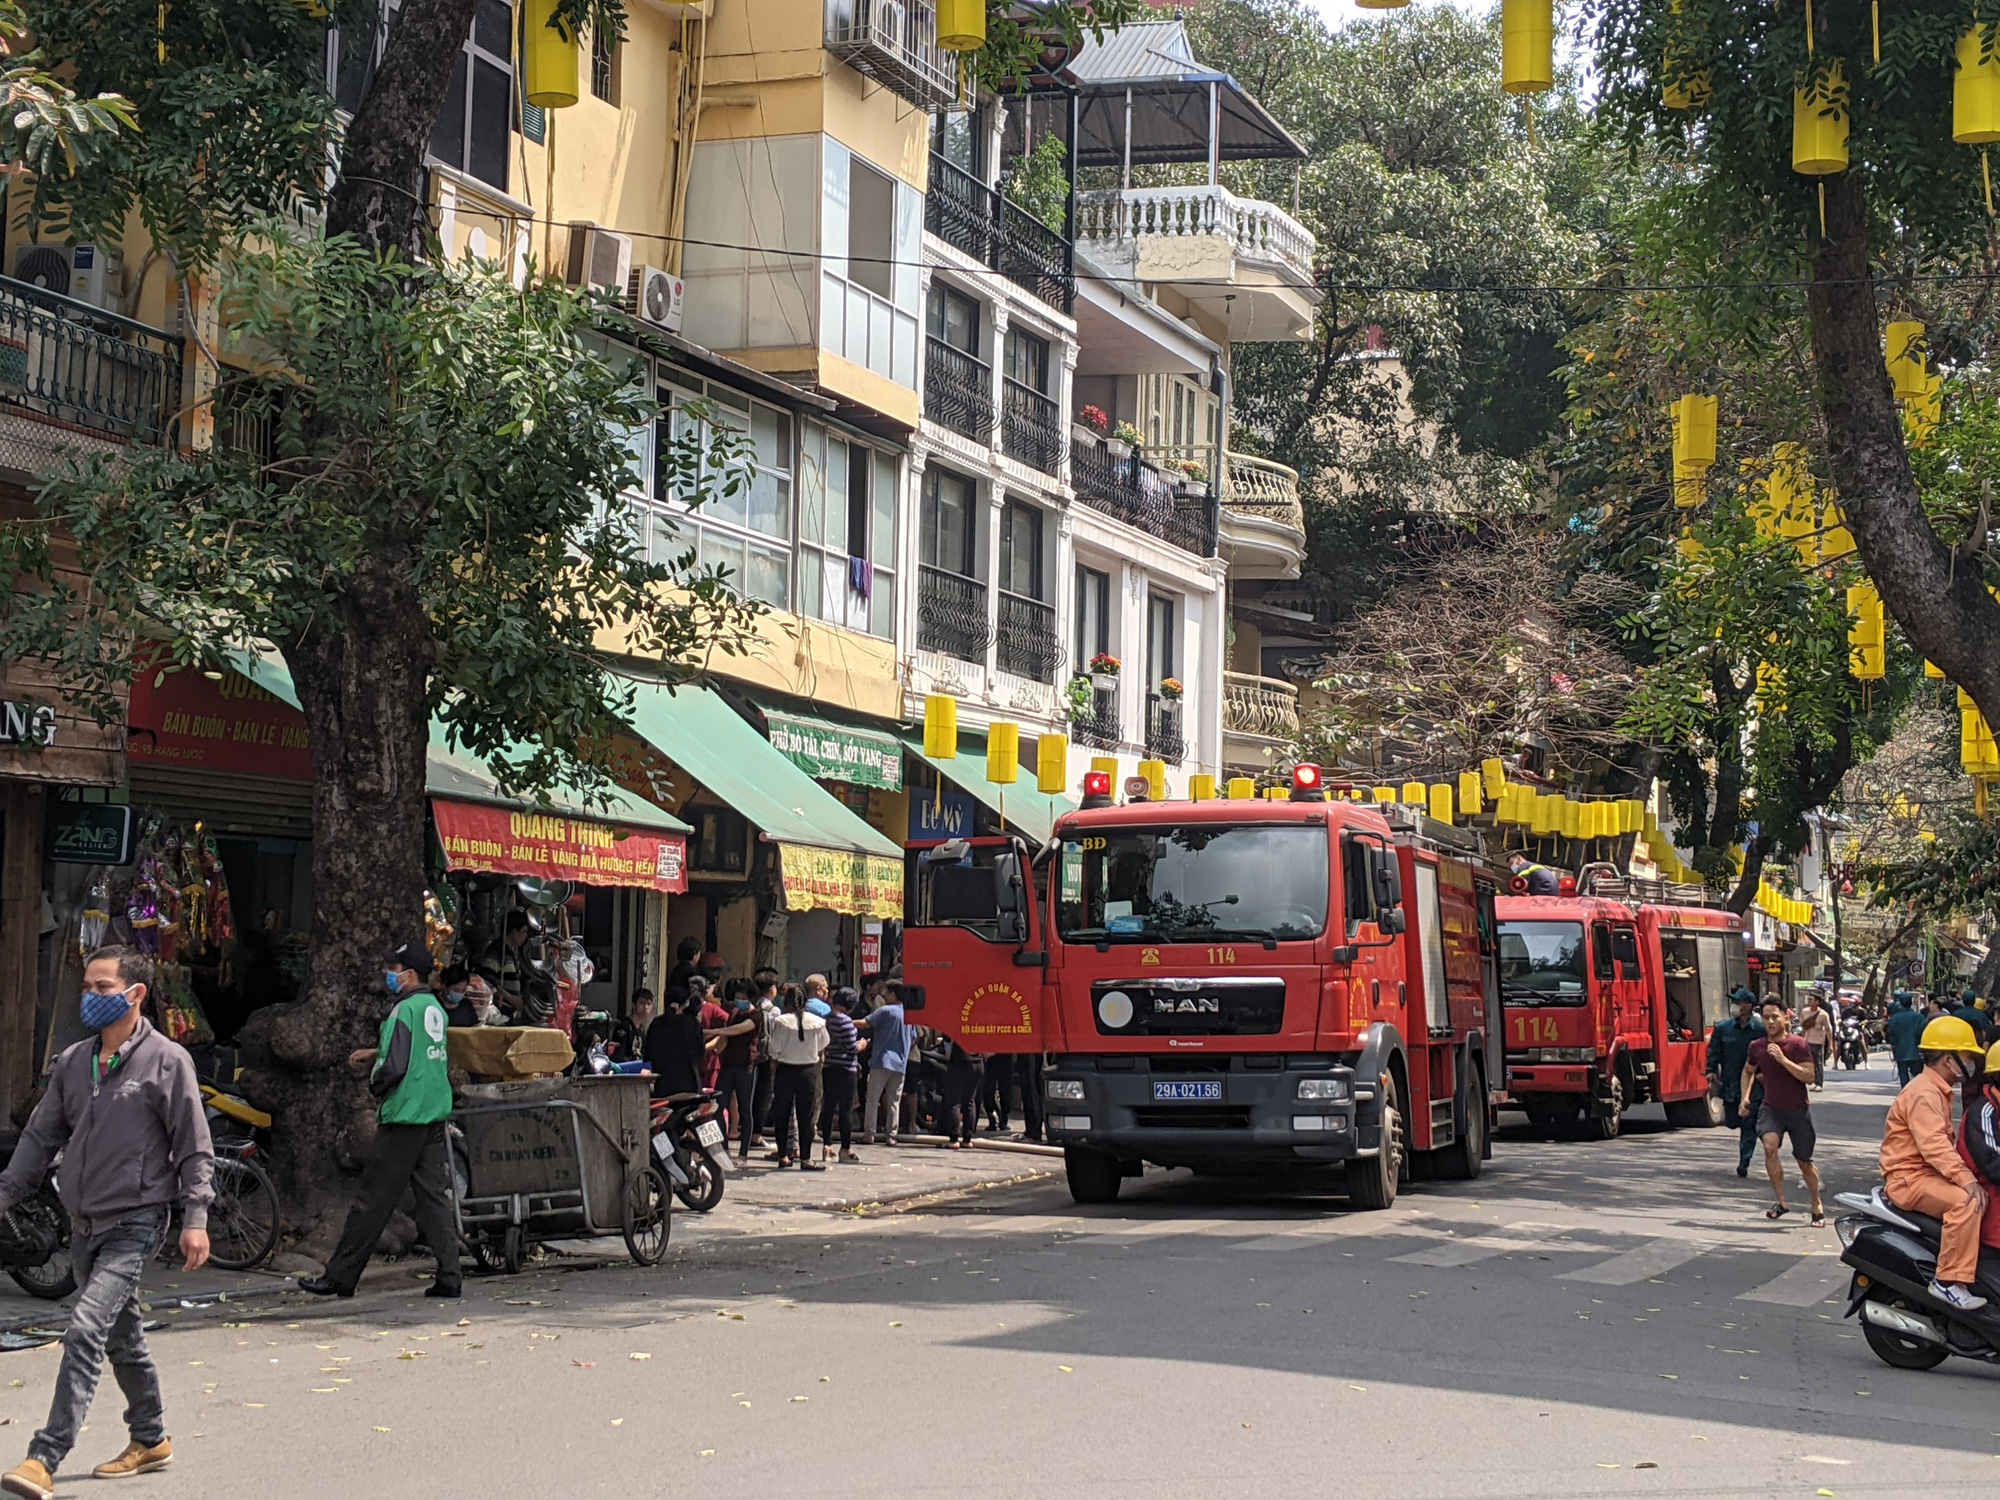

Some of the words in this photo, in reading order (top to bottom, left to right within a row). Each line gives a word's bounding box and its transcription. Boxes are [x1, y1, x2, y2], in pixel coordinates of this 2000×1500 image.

[163, 707, 189, 735] BÁN
[190, 714, 225, 741] BUÔN
[233, 716, 259, 744] BÁN
[510, 811, 567, 843] QUANG
[569, 819, 615, 851] THỊNH
[444, 834, 469, 853] BÁN
[470, 838, 502, 858] BUÔN
[511, 842, 533, 862] BÁN
[552, 847, 578, 867] VÀNG
[1207, 947, 1236, 964] 114
[1154, 998, 1219, 1013] MAN
[1514, 1017, 1559, 1042] 114
